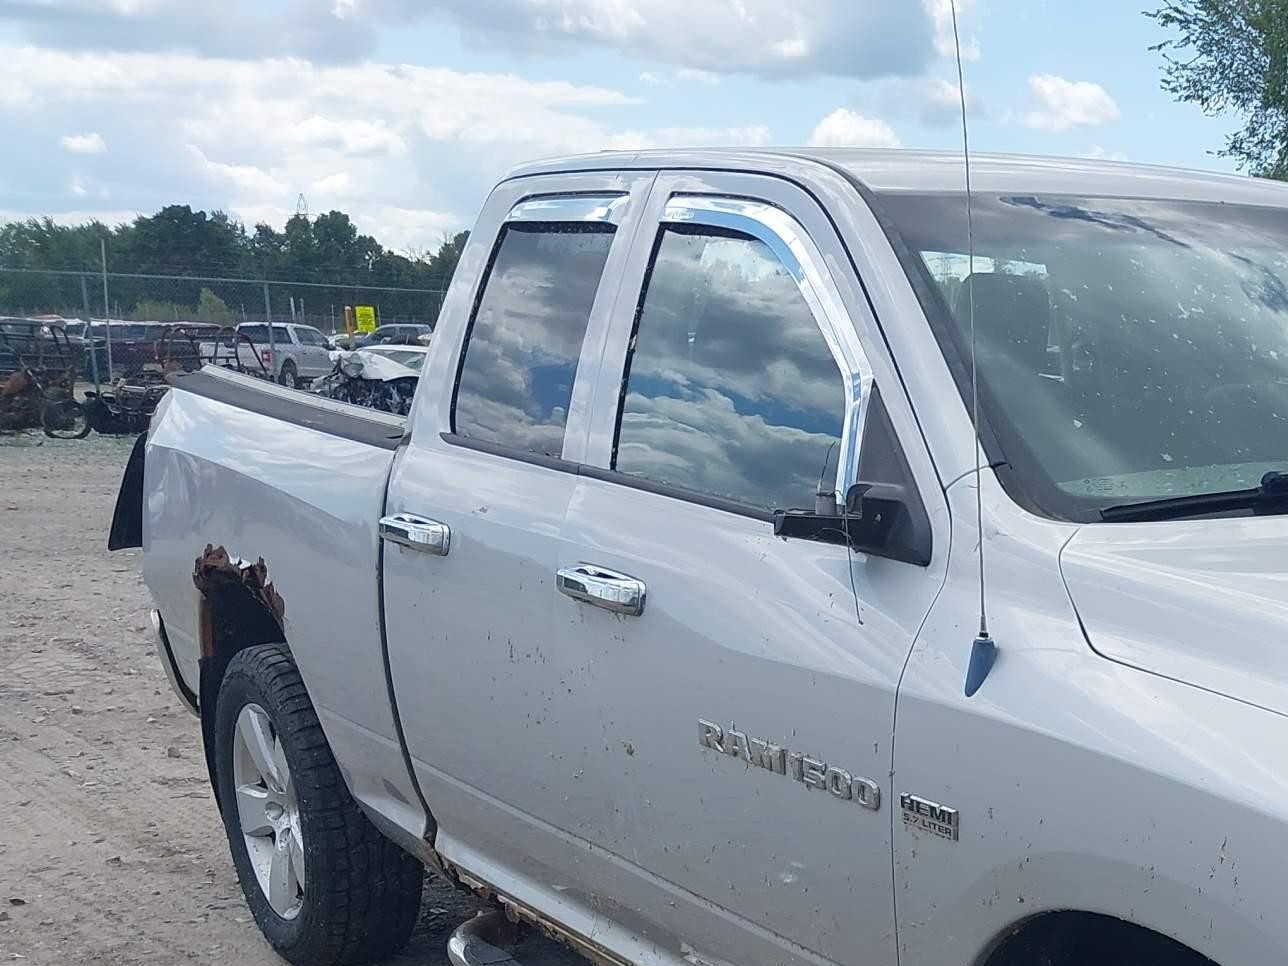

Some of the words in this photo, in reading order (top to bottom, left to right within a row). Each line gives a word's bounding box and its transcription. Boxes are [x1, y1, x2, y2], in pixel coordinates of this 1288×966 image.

[698, 718, 786, 776] RAM
[790, 752, 881, 812] 1500
[900, 792, 954, 825] HEMI
[922, 818, 952, 837] LITER
